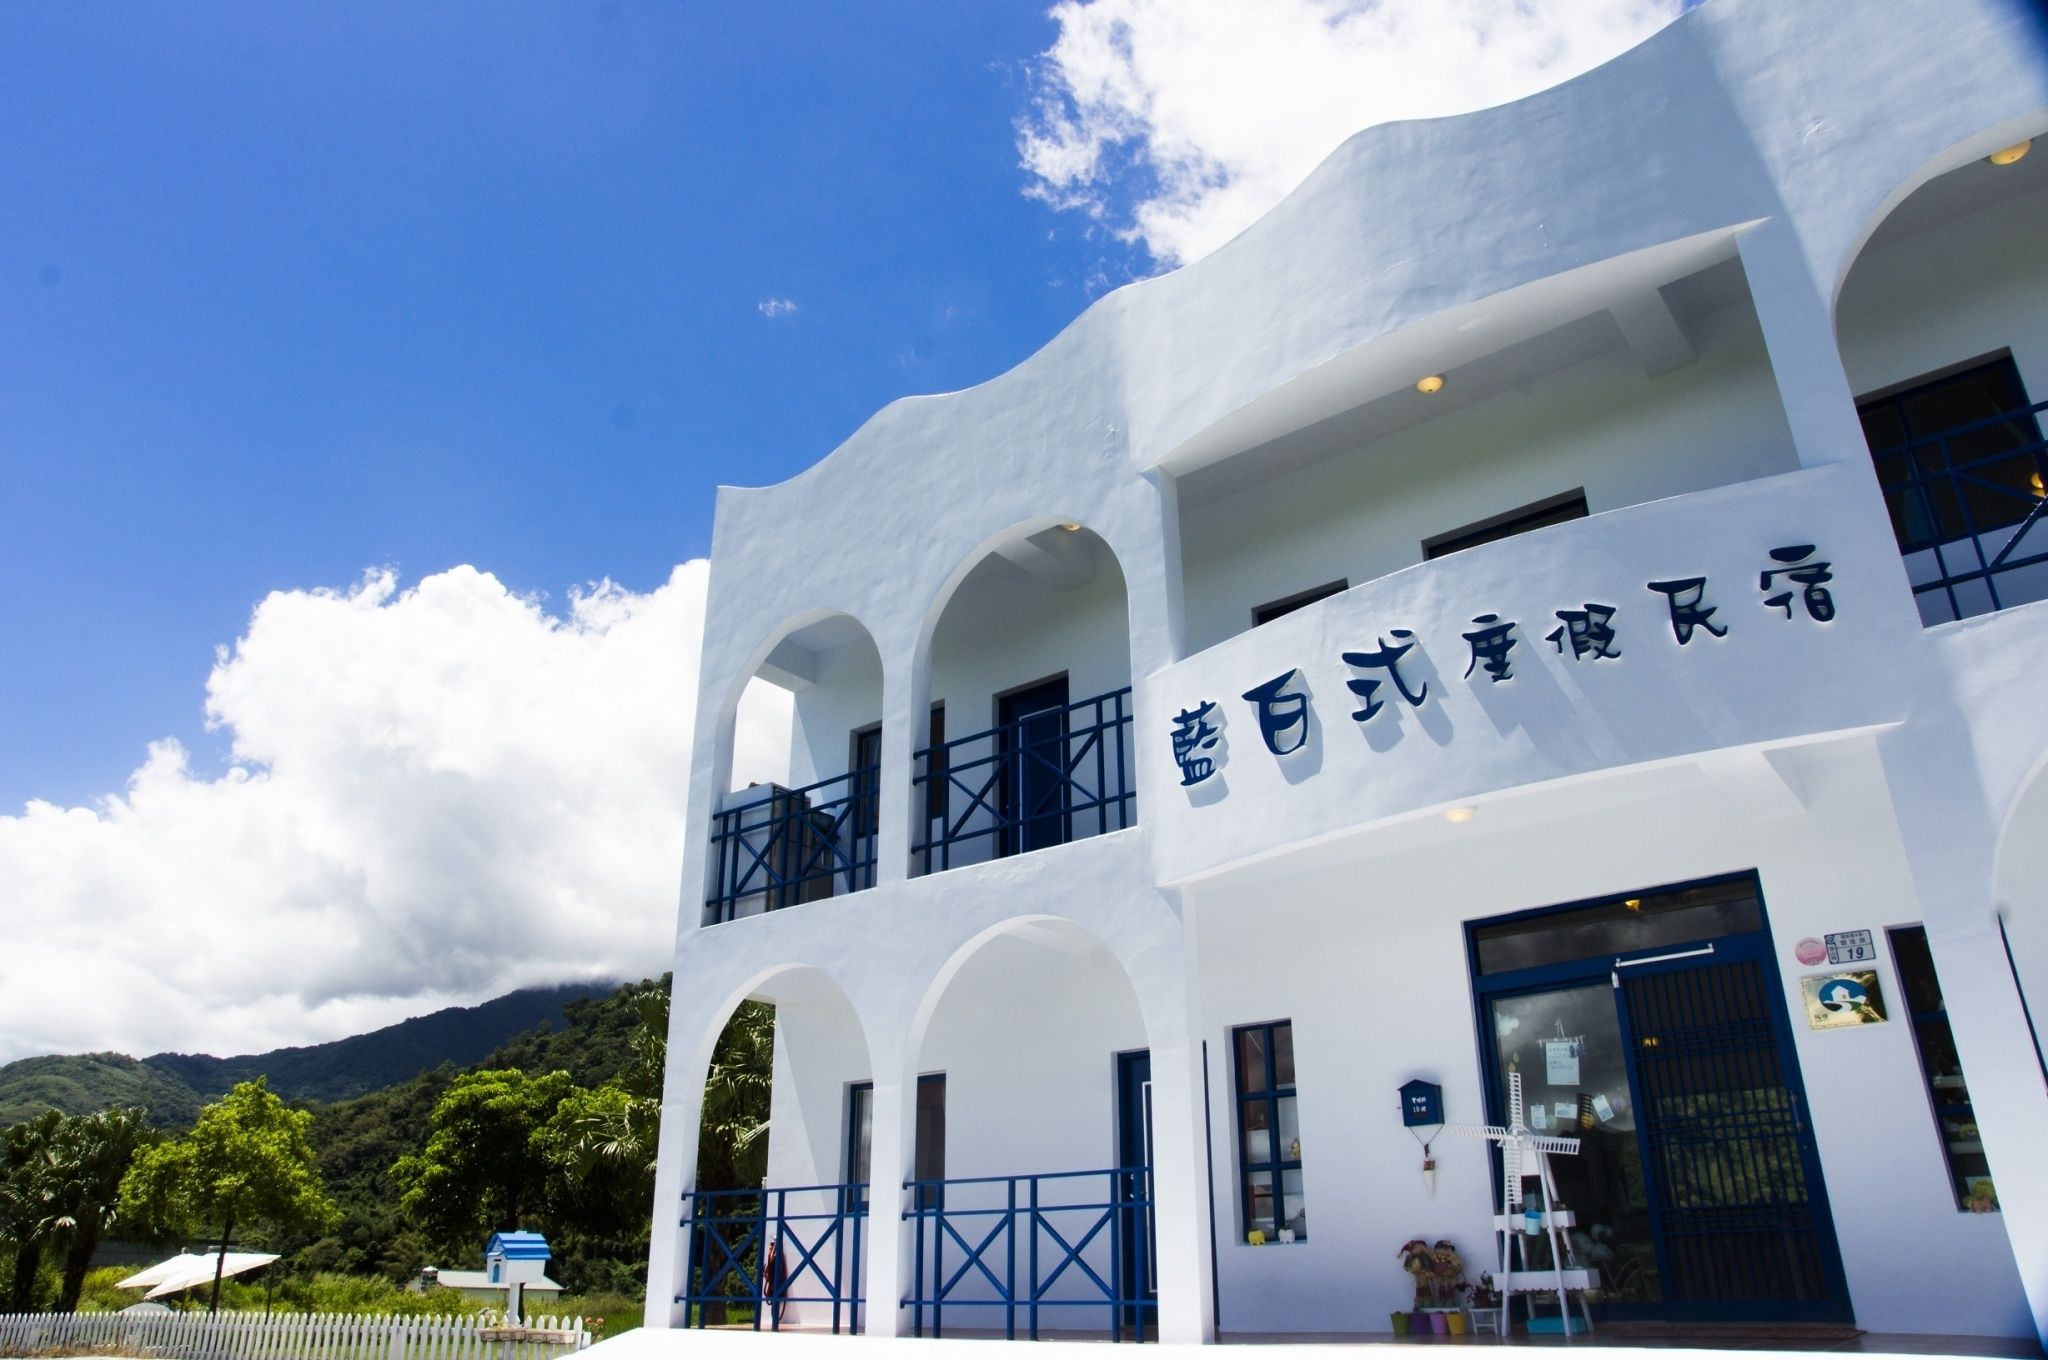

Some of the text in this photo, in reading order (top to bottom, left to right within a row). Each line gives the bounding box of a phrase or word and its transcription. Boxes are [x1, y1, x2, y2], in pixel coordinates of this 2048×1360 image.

[1170, 544, 1836, 786] 藍白式度假民宿
[1847, 946, 1864, 960] 19
